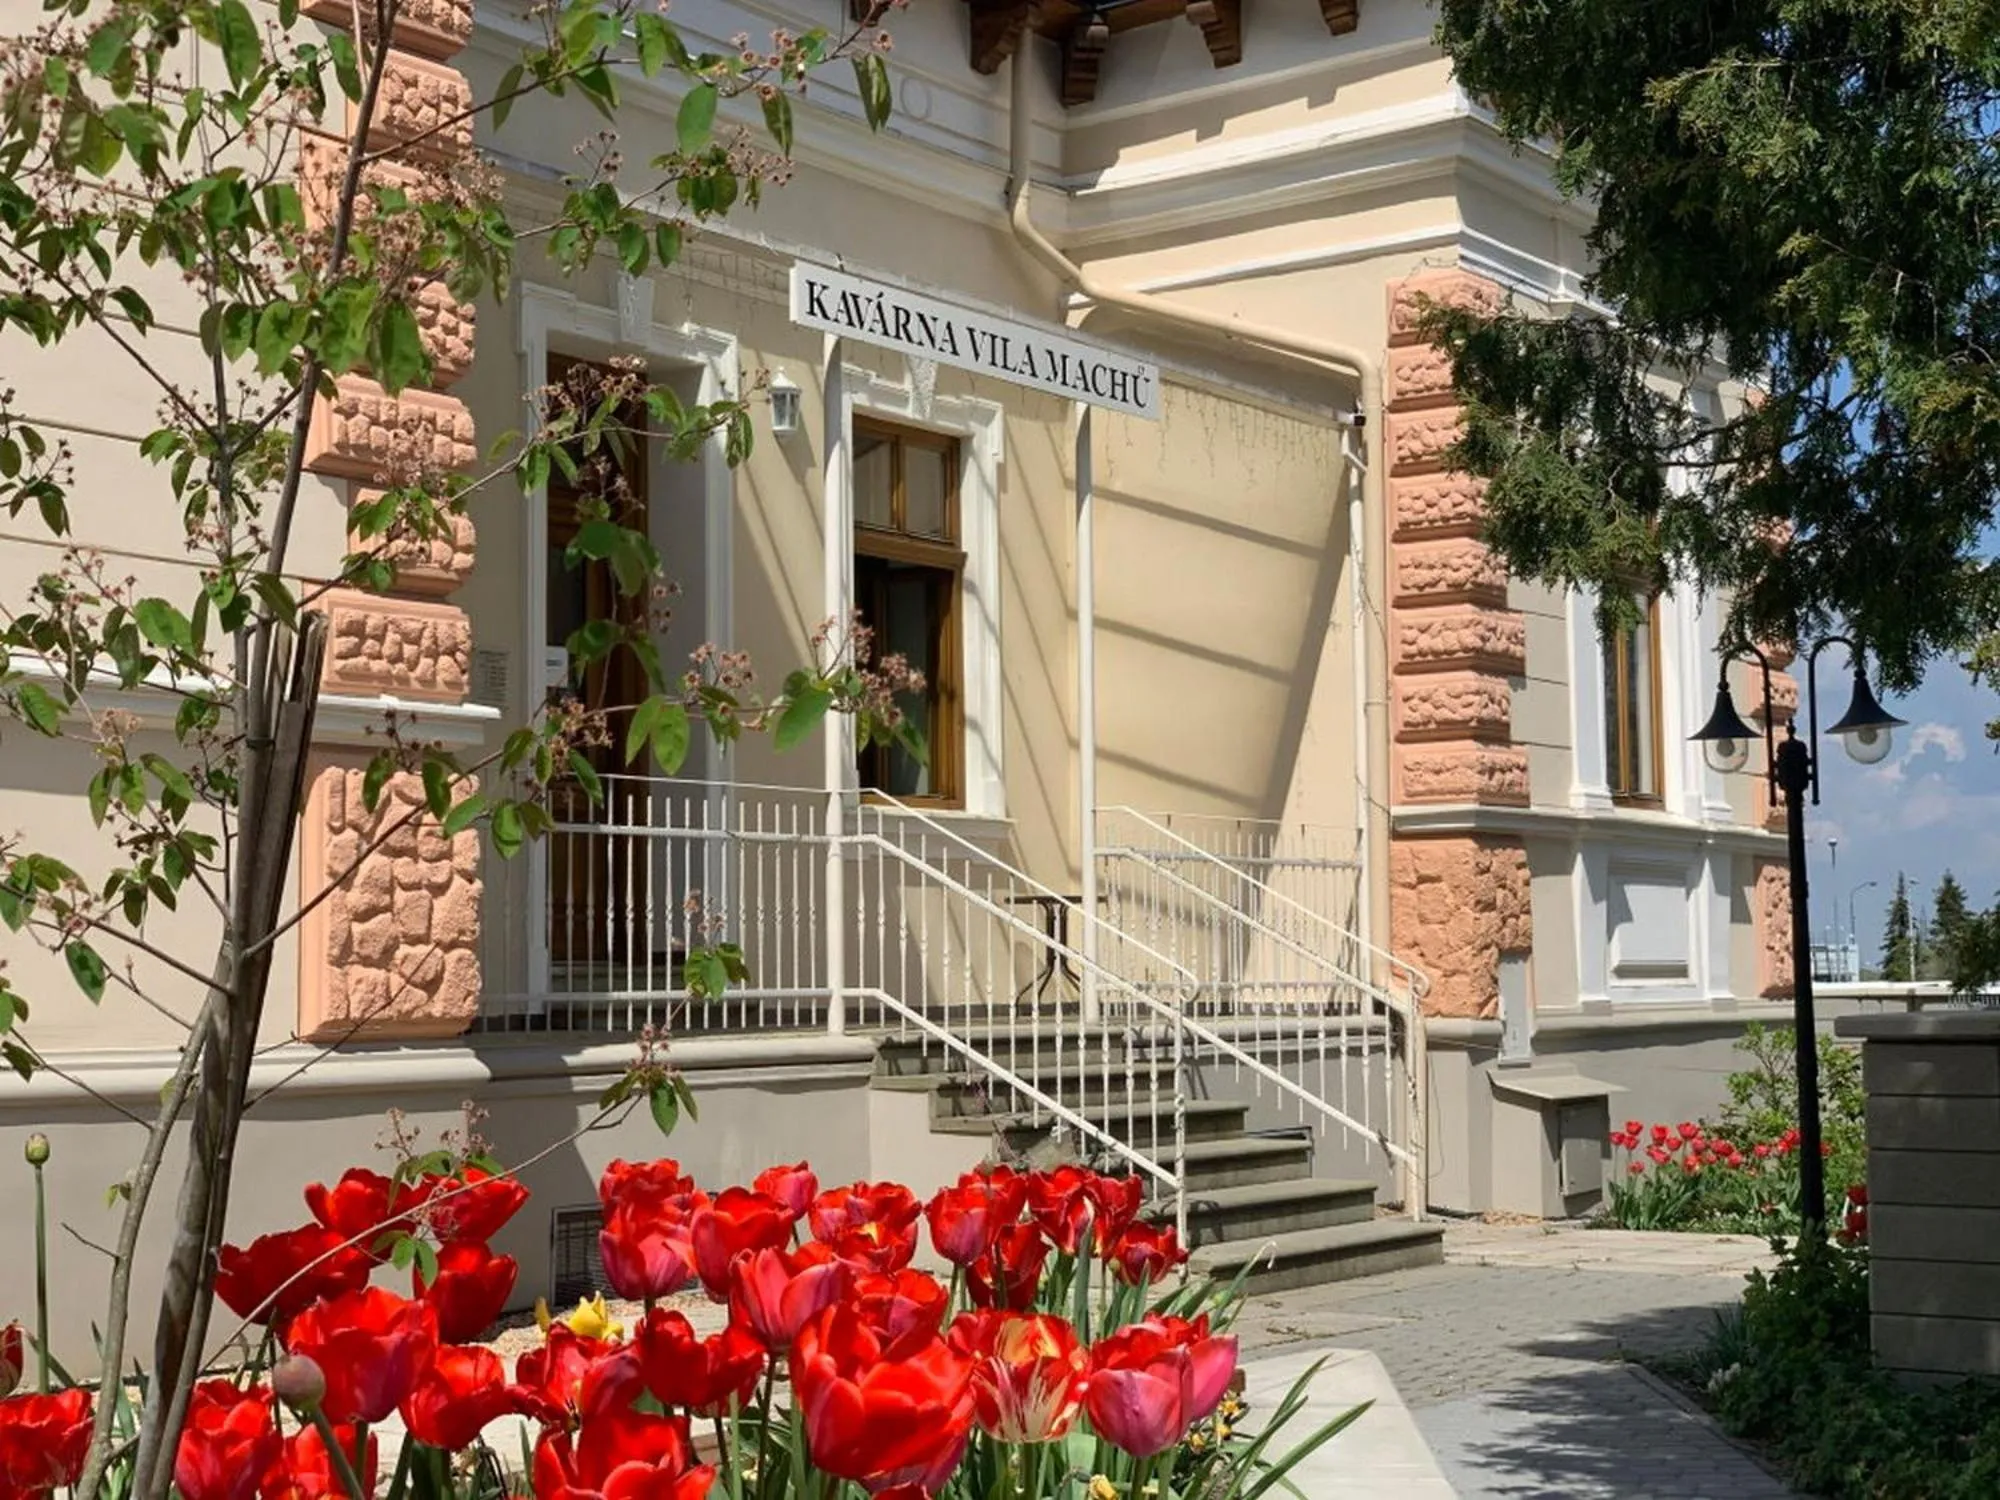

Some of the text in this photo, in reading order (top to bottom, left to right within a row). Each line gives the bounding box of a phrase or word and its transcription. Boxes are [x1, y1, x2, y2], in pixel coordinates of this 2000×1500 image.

[805, 279, 1151, 409] KAVÁRNA VILA MACHŮ
